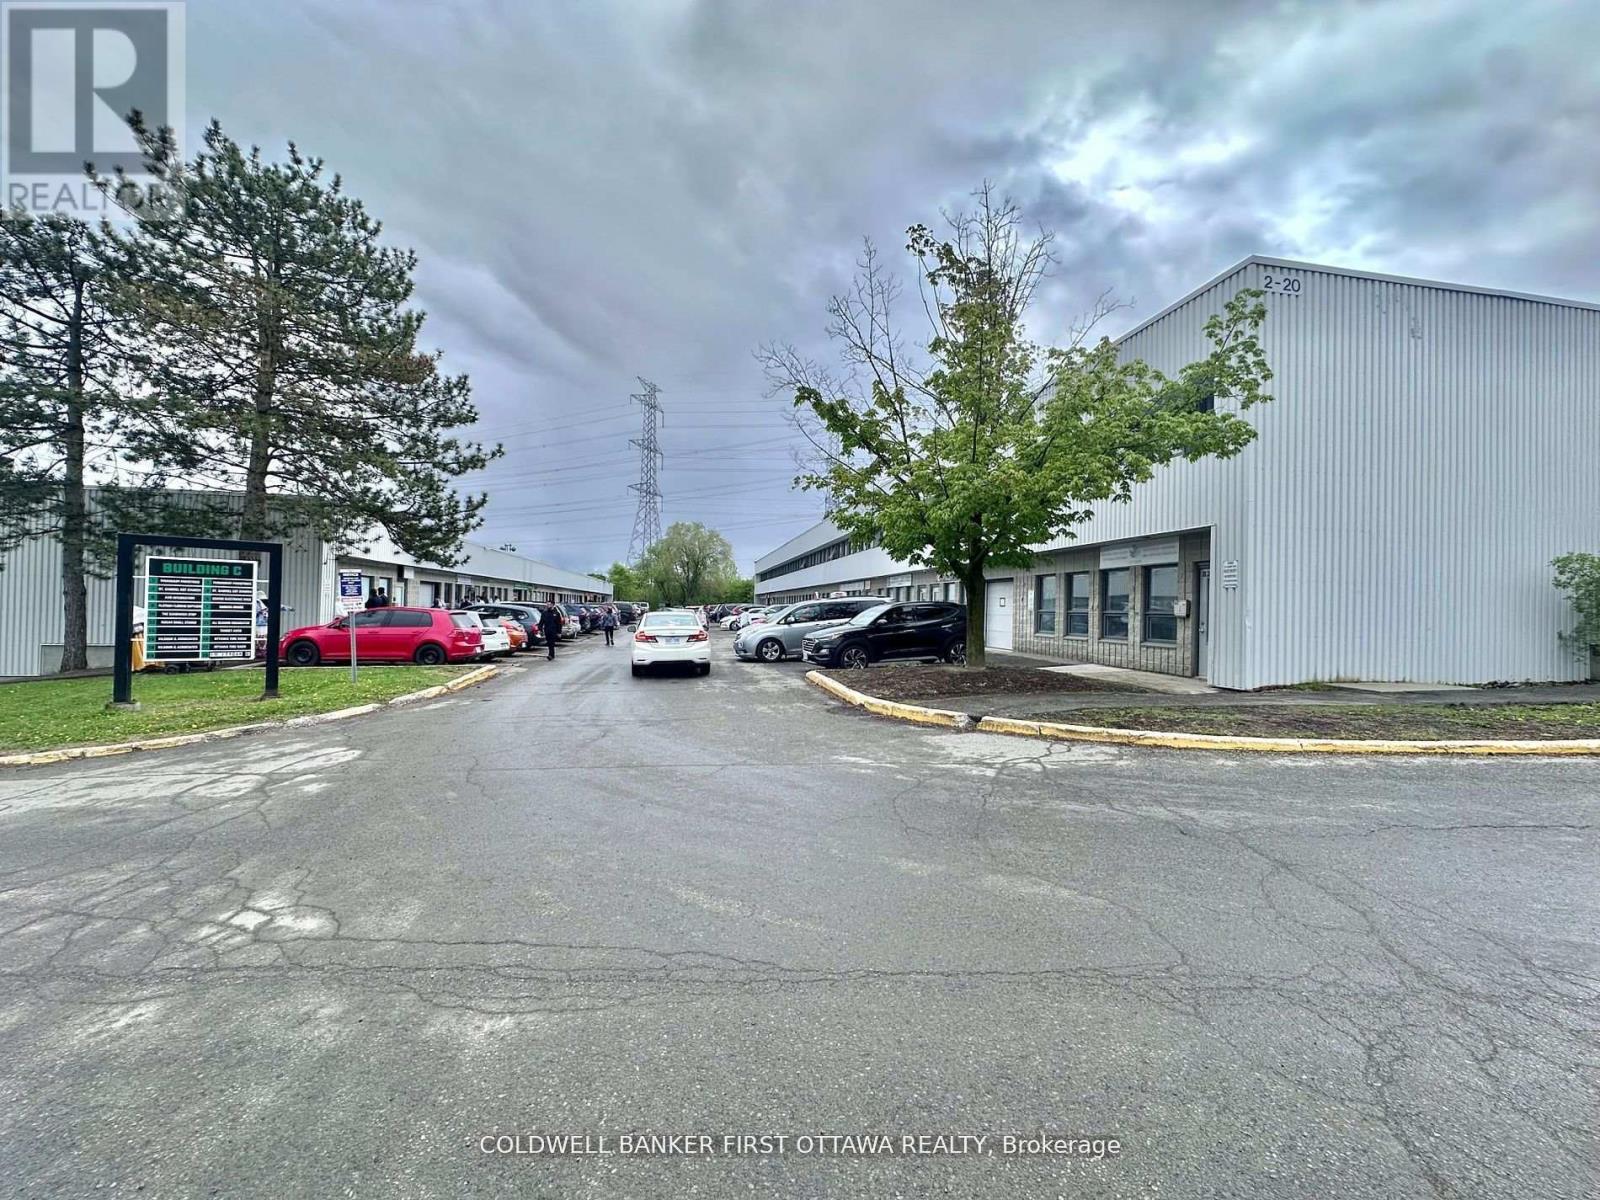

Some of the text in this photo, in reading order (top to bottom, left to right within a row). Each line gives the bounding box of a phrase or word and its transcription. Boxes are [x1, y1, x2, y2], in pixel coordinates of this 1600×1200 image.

[1264, 275, 1301, 293] 2-20
[162, 562, 242, 576] BUILDING C
